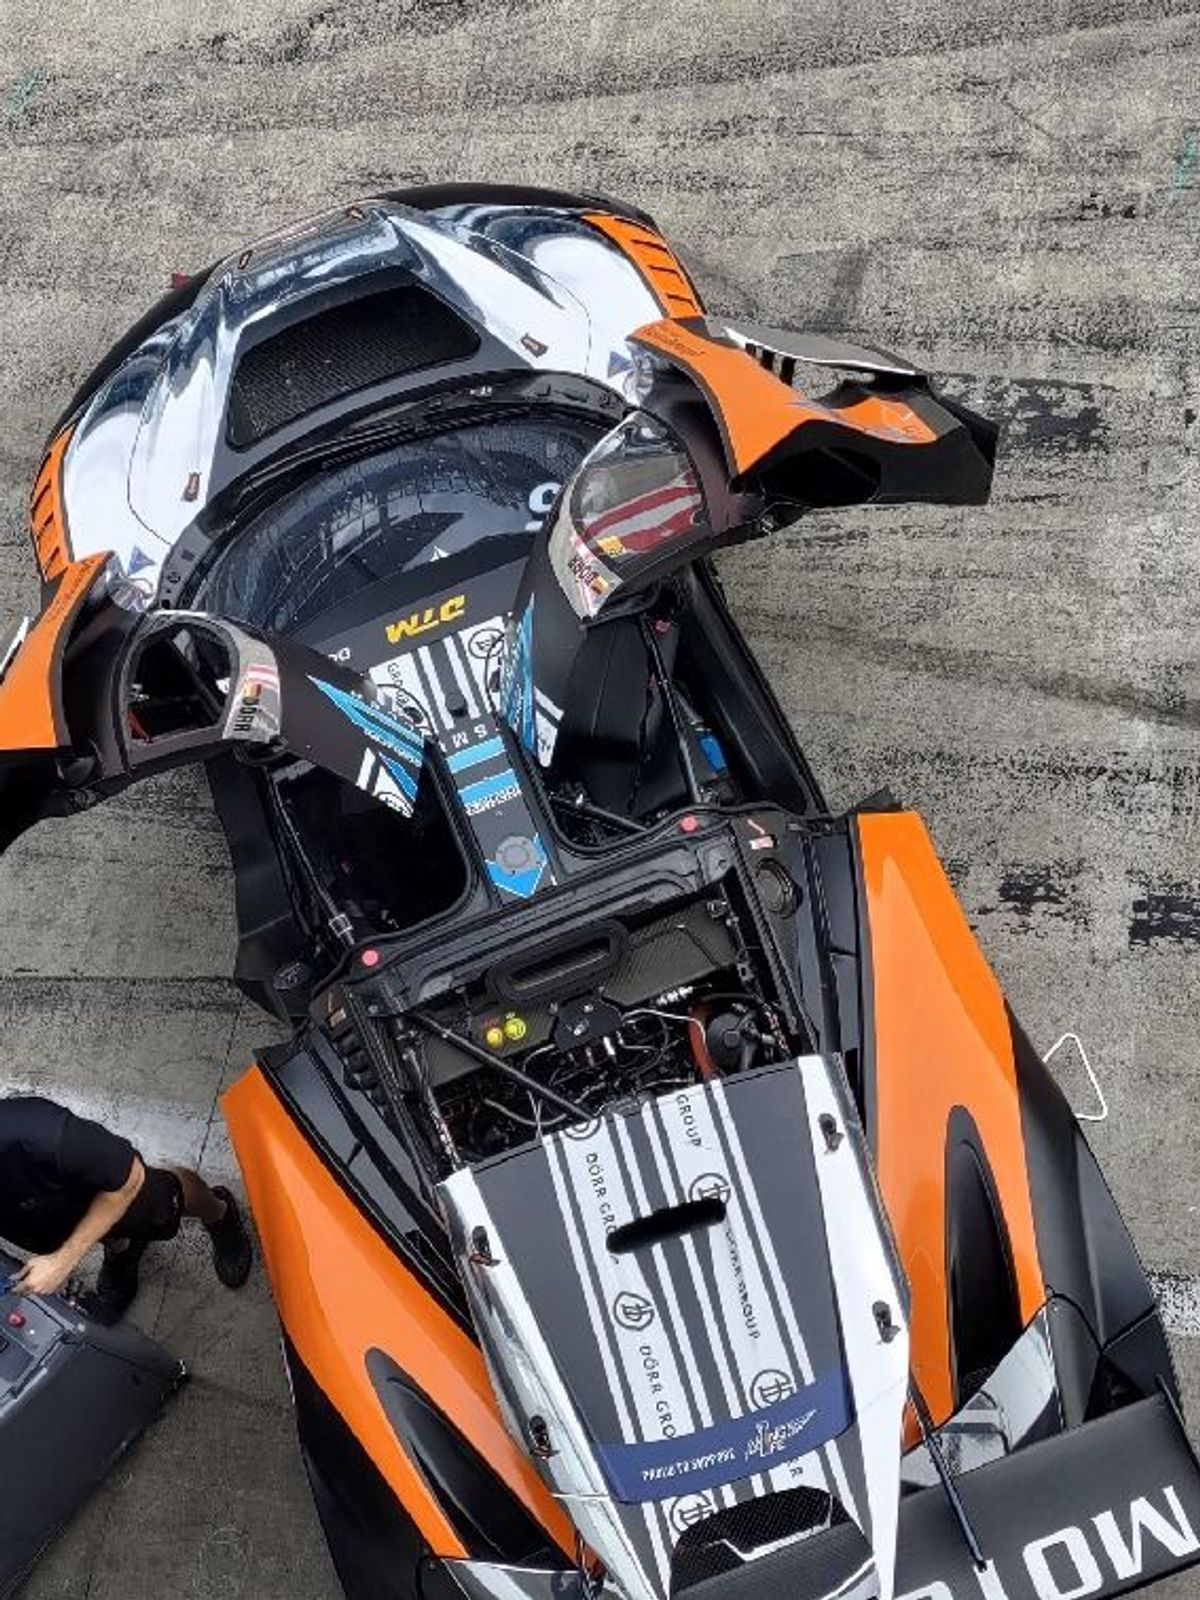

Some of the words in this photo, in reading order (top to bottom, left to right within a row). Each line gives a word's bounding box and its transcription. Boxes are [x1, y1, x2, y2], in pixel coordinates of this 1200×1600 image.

[384, 595, 466, 644] DTM
[676, 1093, 703, 1147] GROUP
[585, 1152, 608, 1197] DÖRR
[656, 1400, 678, 1438] GRO
